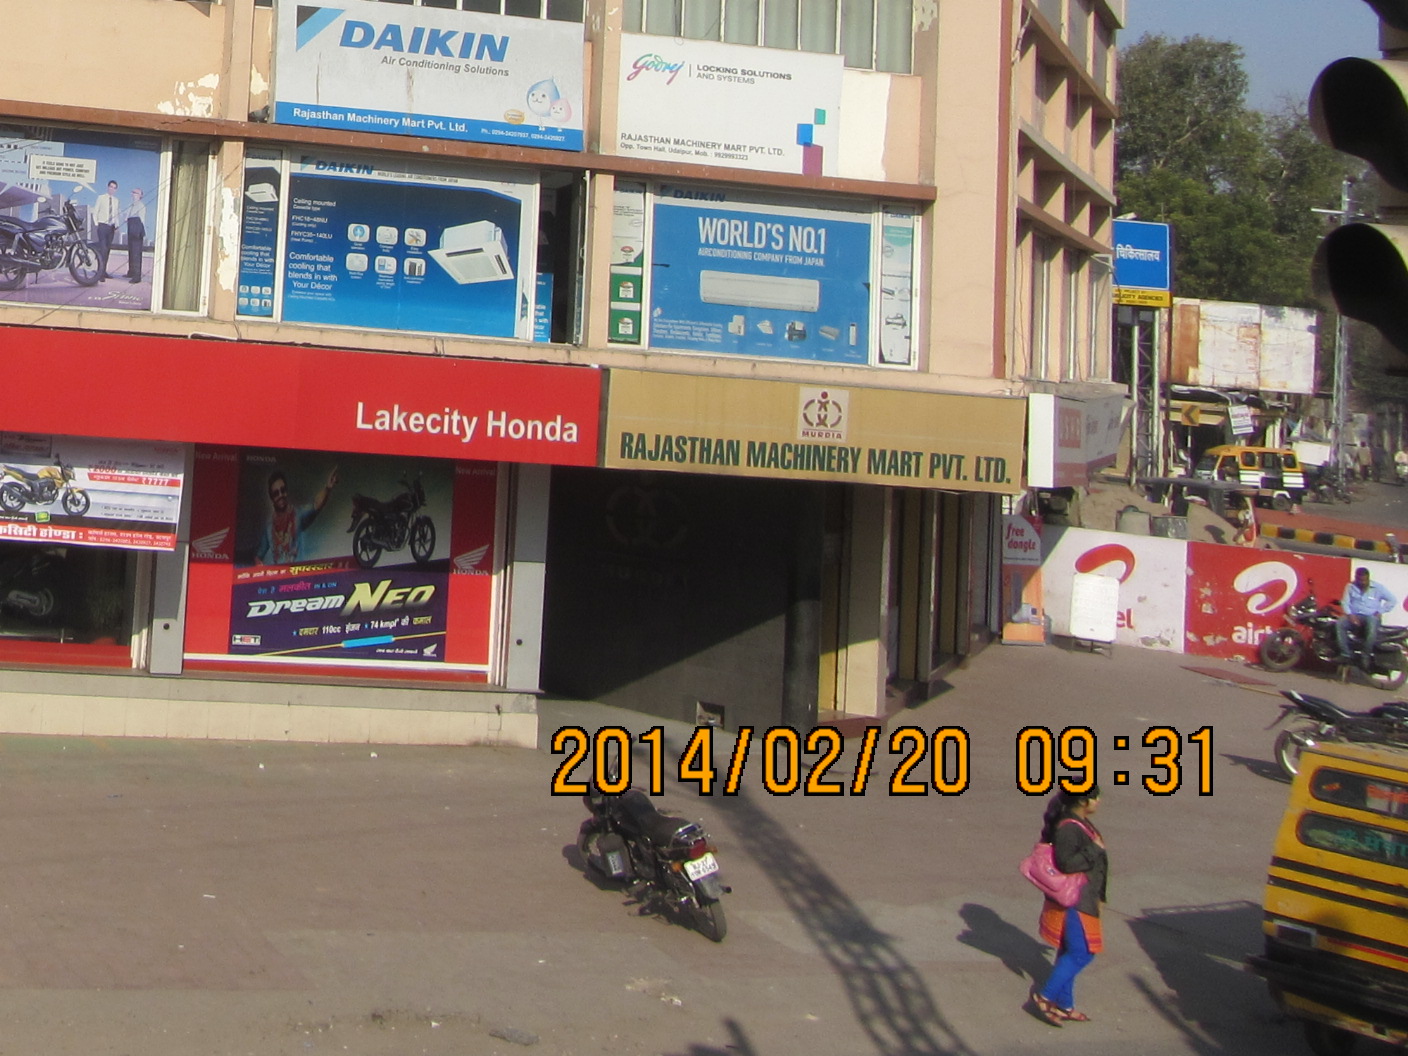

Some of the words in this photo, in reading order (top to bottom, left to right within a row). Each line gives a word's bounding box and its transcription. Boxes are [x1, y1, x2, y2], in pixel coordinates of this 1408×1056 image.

[339, 20, 510, 63] DAIKIN
[381, 55, 396, 65] Air
[398, 57, 461, 74] Conditioning
[463, 64, 510, 76] Solutions
[626, 53, 686, 86] Godrej
[696, 64, 739, 75] LOCKING
[740, 68, 793, 81] SOLUTIONS
[696, 72, 715, 80] AND
[716, 74, 755, 85] SYSTEMS
[293, 107, 345, 121] Rajasthan
[346, 112, 400, 128] Machinery
[401, 117, 426, 129] Mart
[427, 120, 446, 131] Pvt.
[449, 122, 468, 133] Ltd.
[620, 132, 671, 145] RAJASTHAN
[672, 138, 722, 151] MACHINERY
[723, 143, 747, 153] MART
[748, 145, 766, 155] PVT.
[767, 148, 785, 156] LTD.
[620, 142, 635, 150] Opp.
[315, 159, 375, 176] DAIKIN
[673, 189, 726, 203] DAIKIN
[698, 216, 785, 251] WORLD'S
[789, 225, 826, 255] NO.1
[289, 251, 334, 263] Comfortable
[698, 247, 753, 261] AIRCONDITIONING
[753, 252, 784, 263] COMPANY
[784, 255, 803, 265] FROM
[803, 257, 825, 267] JAPAN.
[288, 262, 314, 272] cooling
[316, 264, 331, 272] that
[287, 270, 312, 279] blends
[314, 272, 321, 280] in
[322, 274, 338, 282] with
[292, 280, 309, 288] Your
[356, 401, 478, 443] Lakecity
[486, 410, 578, 443] Honda
[801, 430, 843, 440] MURDIA
[620, 431, 740, 467] RAJASTHAN
[746, 440, 861, 474] MACHINERY
[867, 448, 924, 478] MART
[929, 452, 968, 482] PVT.
[974, 455, 1012, 484] LTD.
[39, 527, 77, 539] होण्डा
[1005, 522, 1025, 540] free
[1008, 539, 1036, 552] dongle
[191, 552, 229, 560] HONDA
[453, 568, 489, 576] HONDA
[246, 594, 346, 618] Dream
[340, 579, 436, 617] NEO
[322, 625, 341, 634] 110cc
[370, 620, 379, 629] 74
